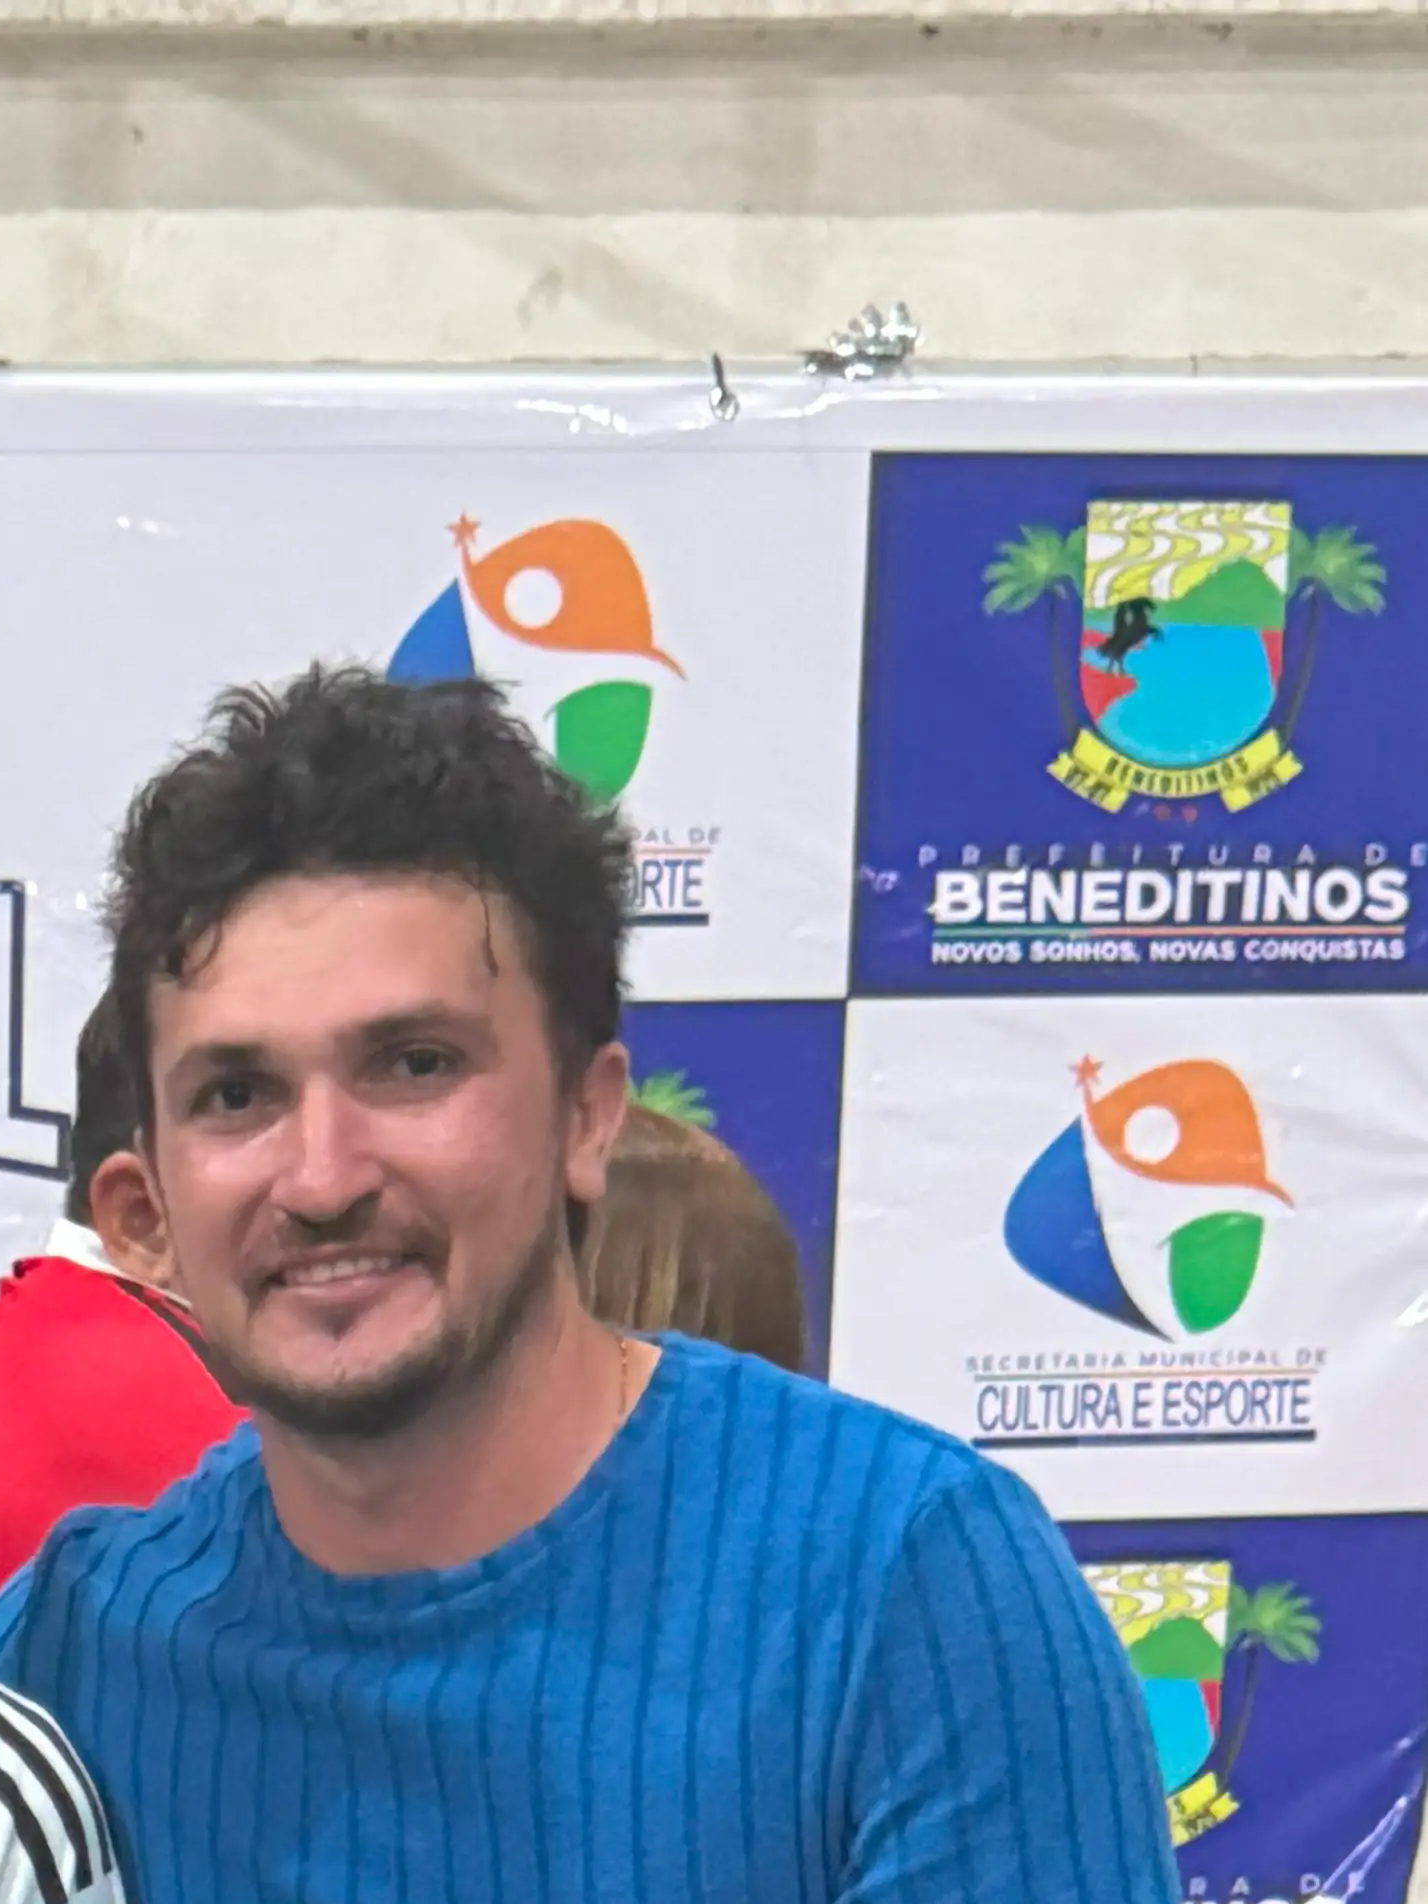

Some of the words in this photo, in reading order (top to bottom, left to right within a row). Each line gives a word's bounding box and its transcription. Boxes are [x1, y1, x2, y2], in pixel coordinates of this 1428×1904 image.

[918, 843, 1317, 867] PREFEITURA
[933, 867, 1410, 924] BENEDITINOS
[931, 940, 1022, 964] NOVOS
[1029, 939, 1142, 964] SONHOS,
[1149, 938, 1236, 962] NOVAS
[1244, 937, 1407, 962] CONQUISTAS
[965, 1353, 1127, 1373] SECRETARIA
[1138, 1350, 1284, 1368] MUNICIPAL
[1295, 1348, 1328, 1367] DE
[976, 1383, 1123, 1432] CULTURA
[1131, 1381, 1153, 1428] E
[1161, 1377, 1312, 1428] ESPORTE
